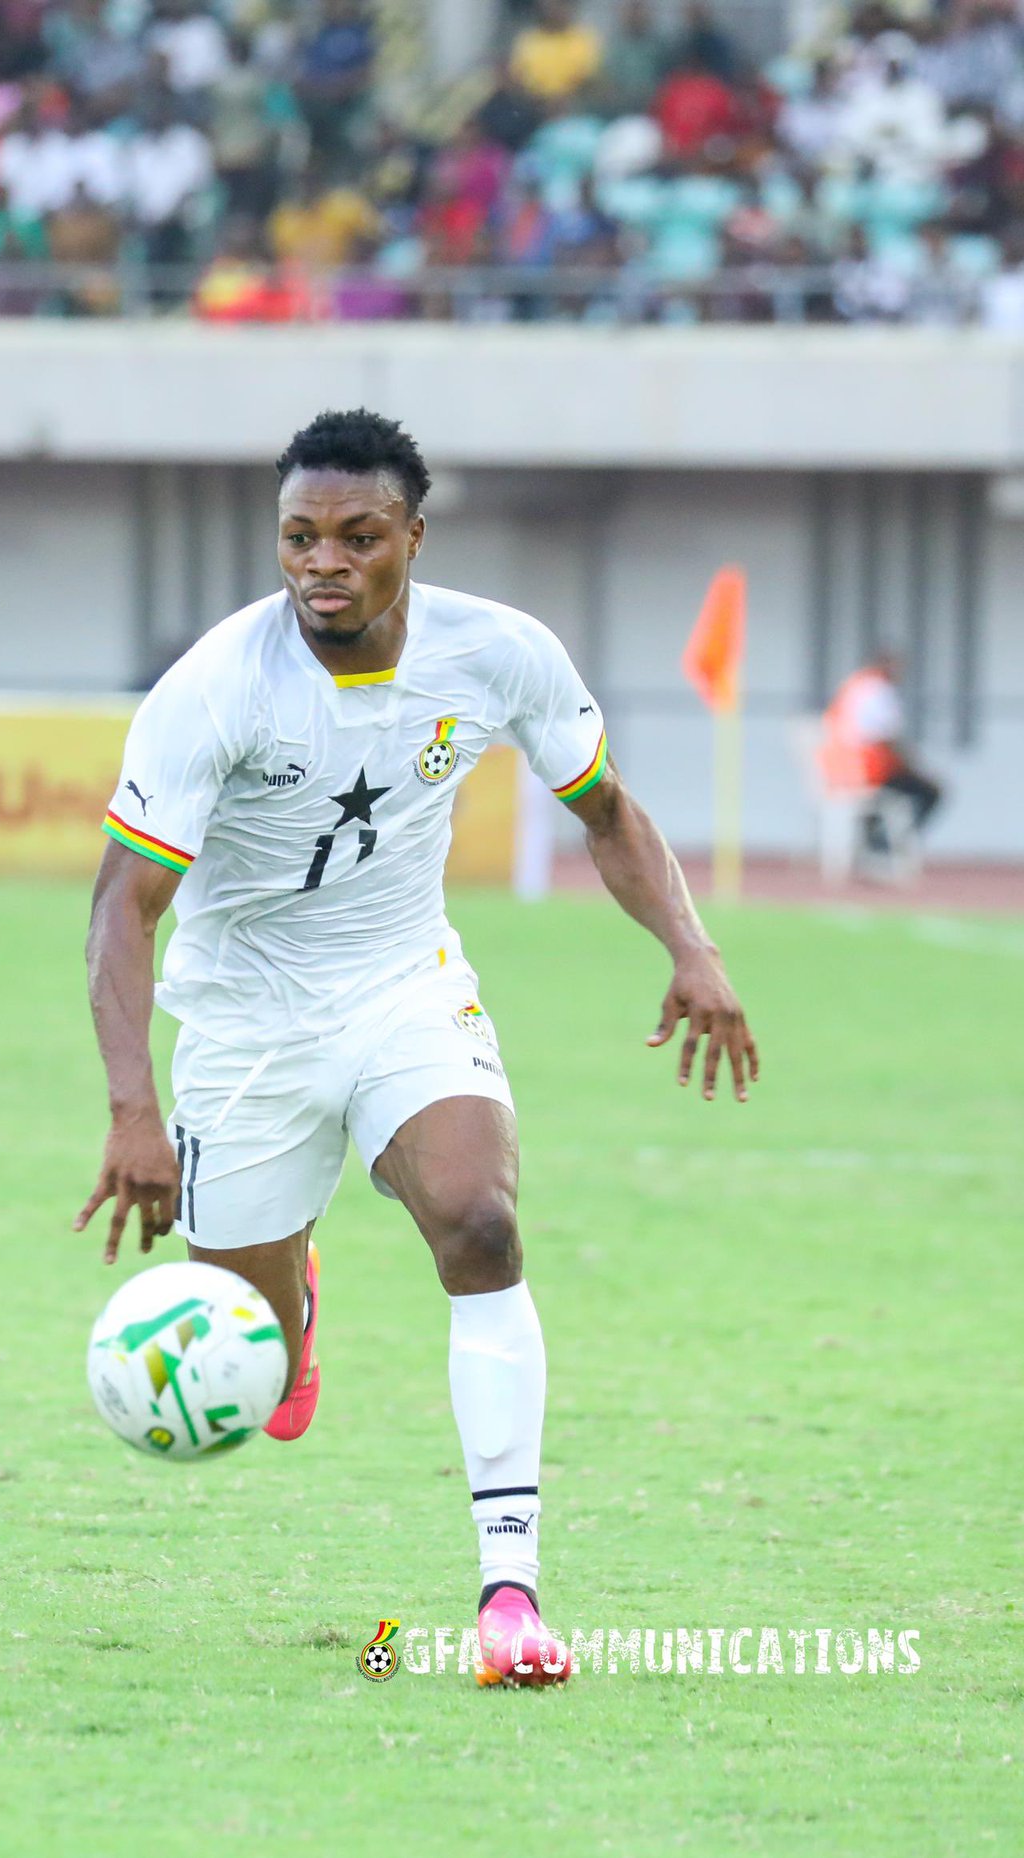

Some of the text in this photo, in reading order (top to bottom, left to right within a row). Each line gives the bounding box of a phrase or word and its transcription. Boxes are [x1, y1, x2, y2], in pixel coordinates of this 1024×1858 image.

[262, 770, 301, 787] PUMA
[174, 1123, 202, 1234] 11
[486, 1524, 527, 1535] PUMA
